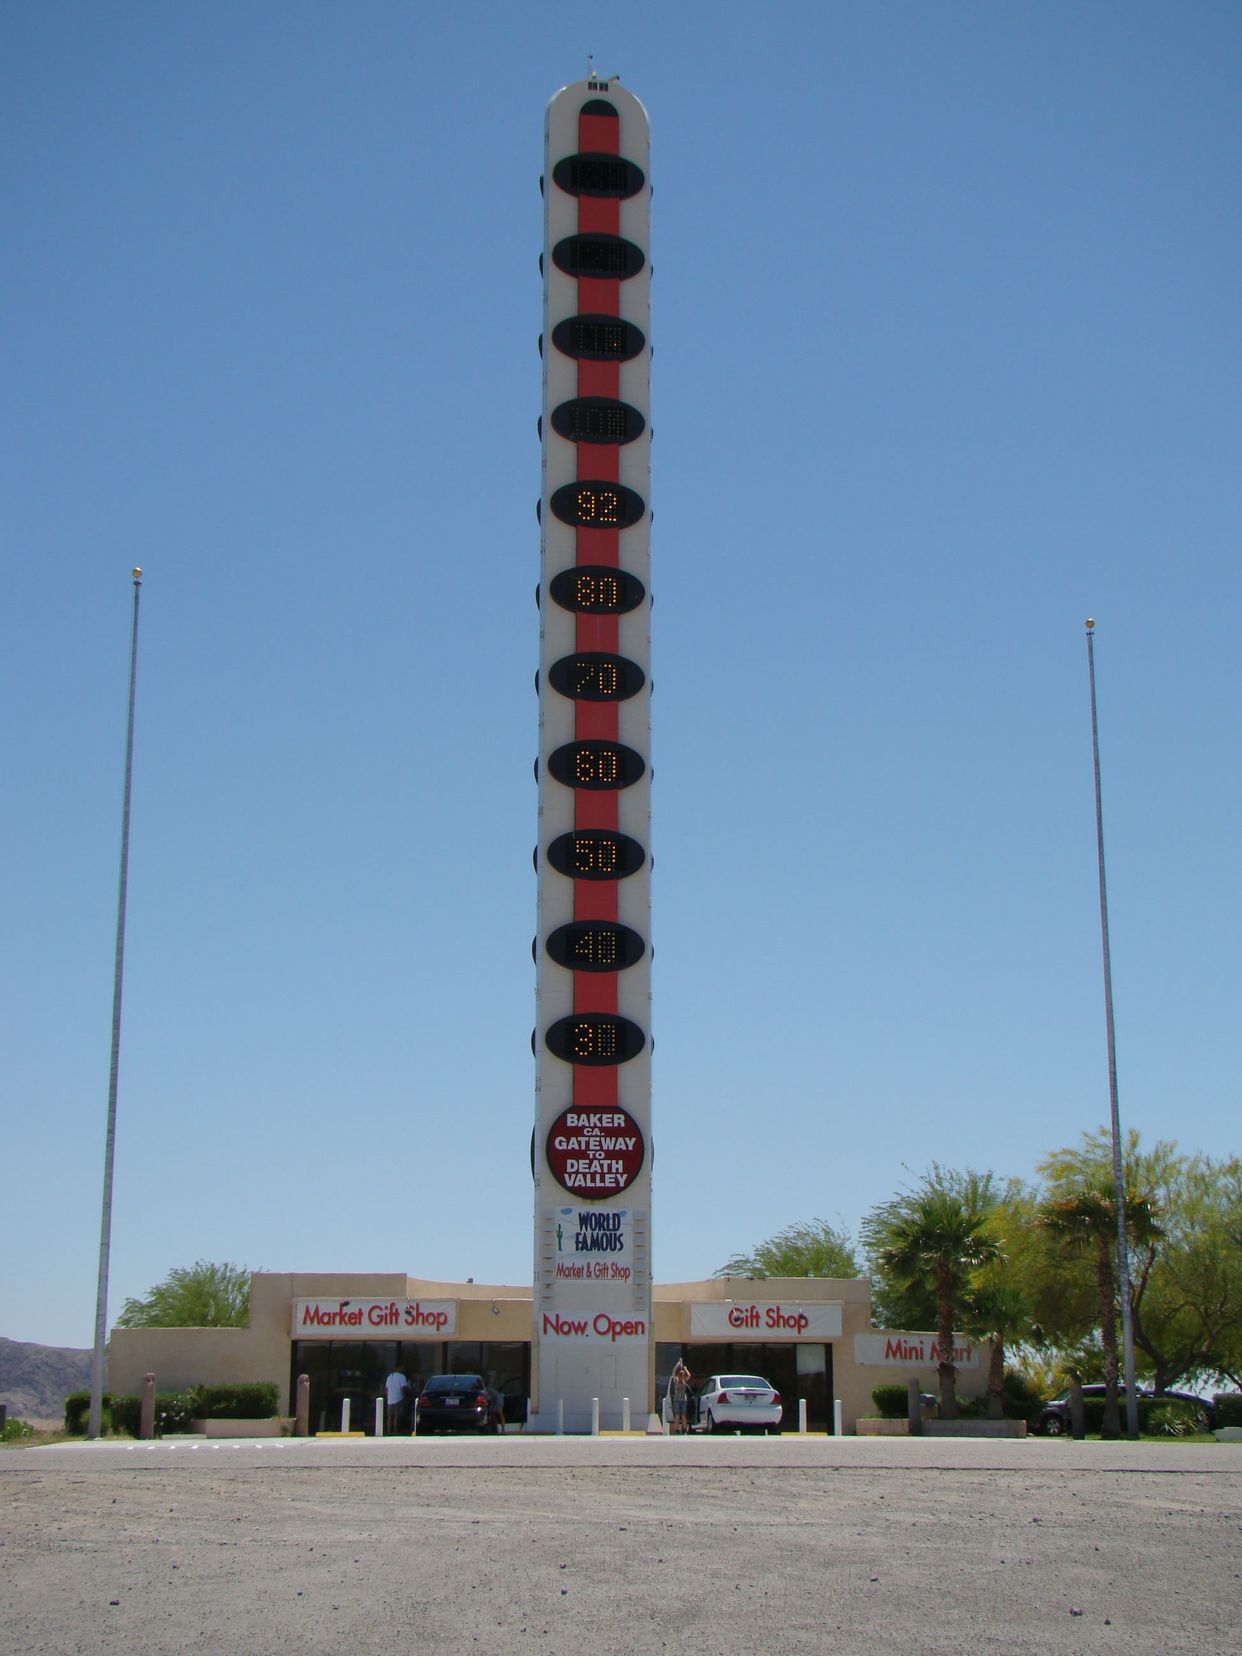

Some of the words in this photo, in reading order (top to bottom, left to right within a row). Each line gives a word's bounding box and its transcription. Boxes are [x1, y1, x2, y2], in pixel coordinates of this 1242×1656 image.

[578, 491, 617, 522] 92
[577, 576, 617, 607] 80
[577, 663, 616, 694] 70
[576, 751, 616, 782] 60
[575, 840, 616, 872] 50
[575, 931, 615, 963] 40
[575, 1023, 615, 1057] 30
[566, 1113, 625, 1127] BAKER
[583, 1128, 605, 1136] CA.
[554, 1136, 637, 1150] GATEWAY
[586, 1151, 605, 1159] TO
[566, 1159, 623, 1173] DEATH
[564, 1173, 628, 1187] VALLEY
[578, 1212, 621, 1232] WORLD
[574, 1232, 625, 1252] FAMOUS
[556, 1262, 585, 1279] Market
[586, 1262, 592, 1279] &
[593, 1262, 609, 1279] Gift
[610, 1262, 631, 1283] Shop
[302, 1302, 364, 1326] Market
[368, 1302, 400, 1326] Gift
[404, 1302, 448, 1332] Shop
[543, 1312, 588, 1336] Now
[593, 1313, 645, 1342] Open
[728, 1305, 760, 1329] Gift
[765, 1305, 809, 1335] Shop
[885, 1338, 924, 1361] Mini
